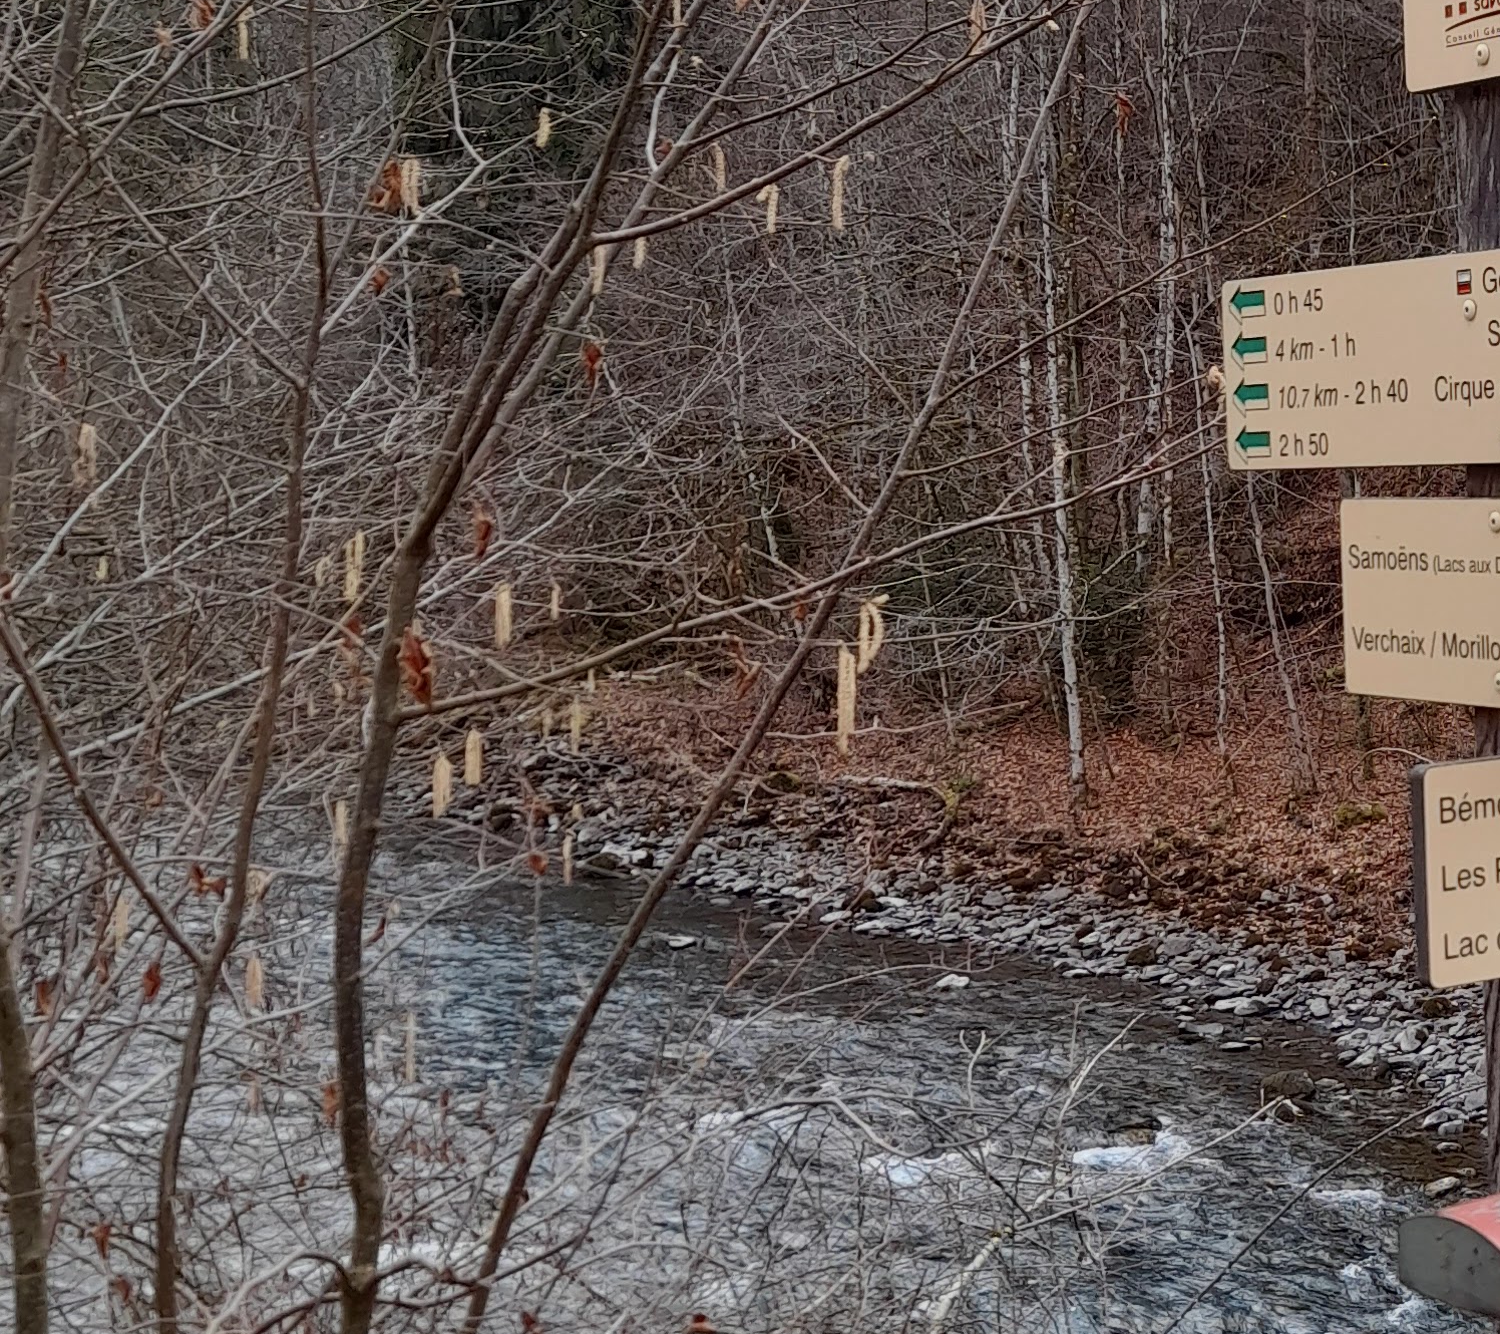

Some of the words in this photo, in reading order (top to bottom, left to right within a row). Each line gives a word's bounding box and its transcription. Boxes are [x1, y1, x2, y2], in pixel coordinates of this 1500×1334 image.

[1274, 292, 1284, 315] 0
[1288, 291, 1298, 313] h
[1303, 289, 1323, 311] 45
[1275, 340, 1284, 361] 4
[1290, 338, 1313, 361] km
[1331, 334, 1338, 357] 1
[1346, 332, 1356, 356] h
[1279, 386, 1309, 409] 10.7
[1314, 383, 1338, 407] km
[1355, 381, 1365, 404] 2
[1371, 380, 1381, 403] h
[1387, 378, 1408, 403] 40
[1434, 375, 1495, 407] Cirque
[1279, 434, 1289, 457] 2
[1294, 433, 1303, 456] h
[1309, 433, 1328, 456] 50
[1348, 544, 1429, 571] Samoëns
[1433, 555, 1465, 575] (Lacs
[1469, 560, 1491, 573] aux
[1352, 627, 1425, 655] Verchaix
[1442, 865, 1486, 892] Les
[1444, 930, 1488, 960] Lac
